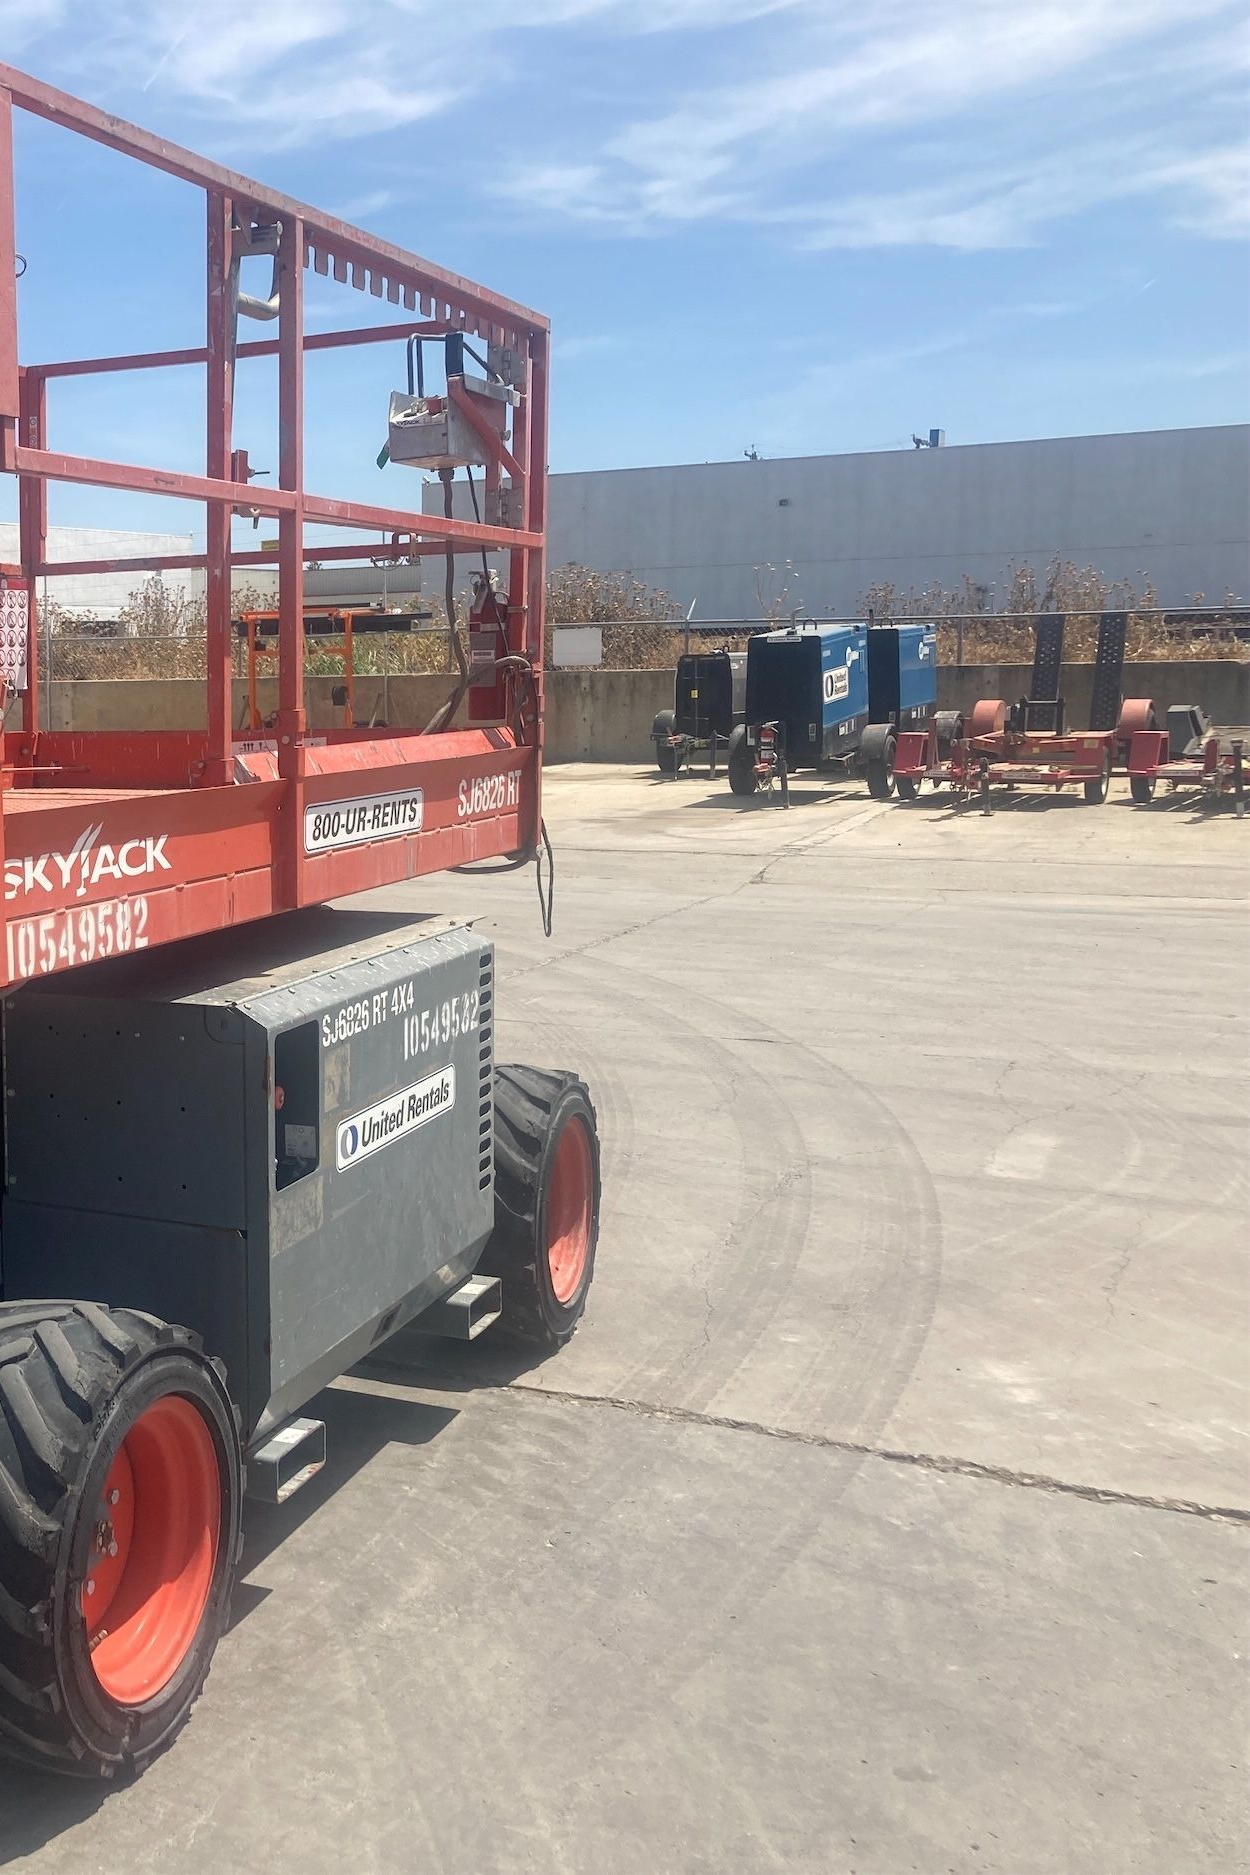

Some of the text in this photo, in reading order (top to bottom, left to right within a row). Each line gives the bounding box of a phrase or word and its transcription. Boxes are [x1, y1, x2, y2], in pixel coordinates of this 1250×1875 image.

[312, 797, 418, 842] 800-UR-RENTS
[457, 769, 522, 817] SJ6826 RT
[3, 821, 173, 901] SKYJACK
[6, 896, 150, 982] 10549582
[322, 980, 415, 1048] SJ6826 RT 4X4
[403, 989, 480, 1062] 10549582
[361, 1078, 450, 1148] United Rentals
